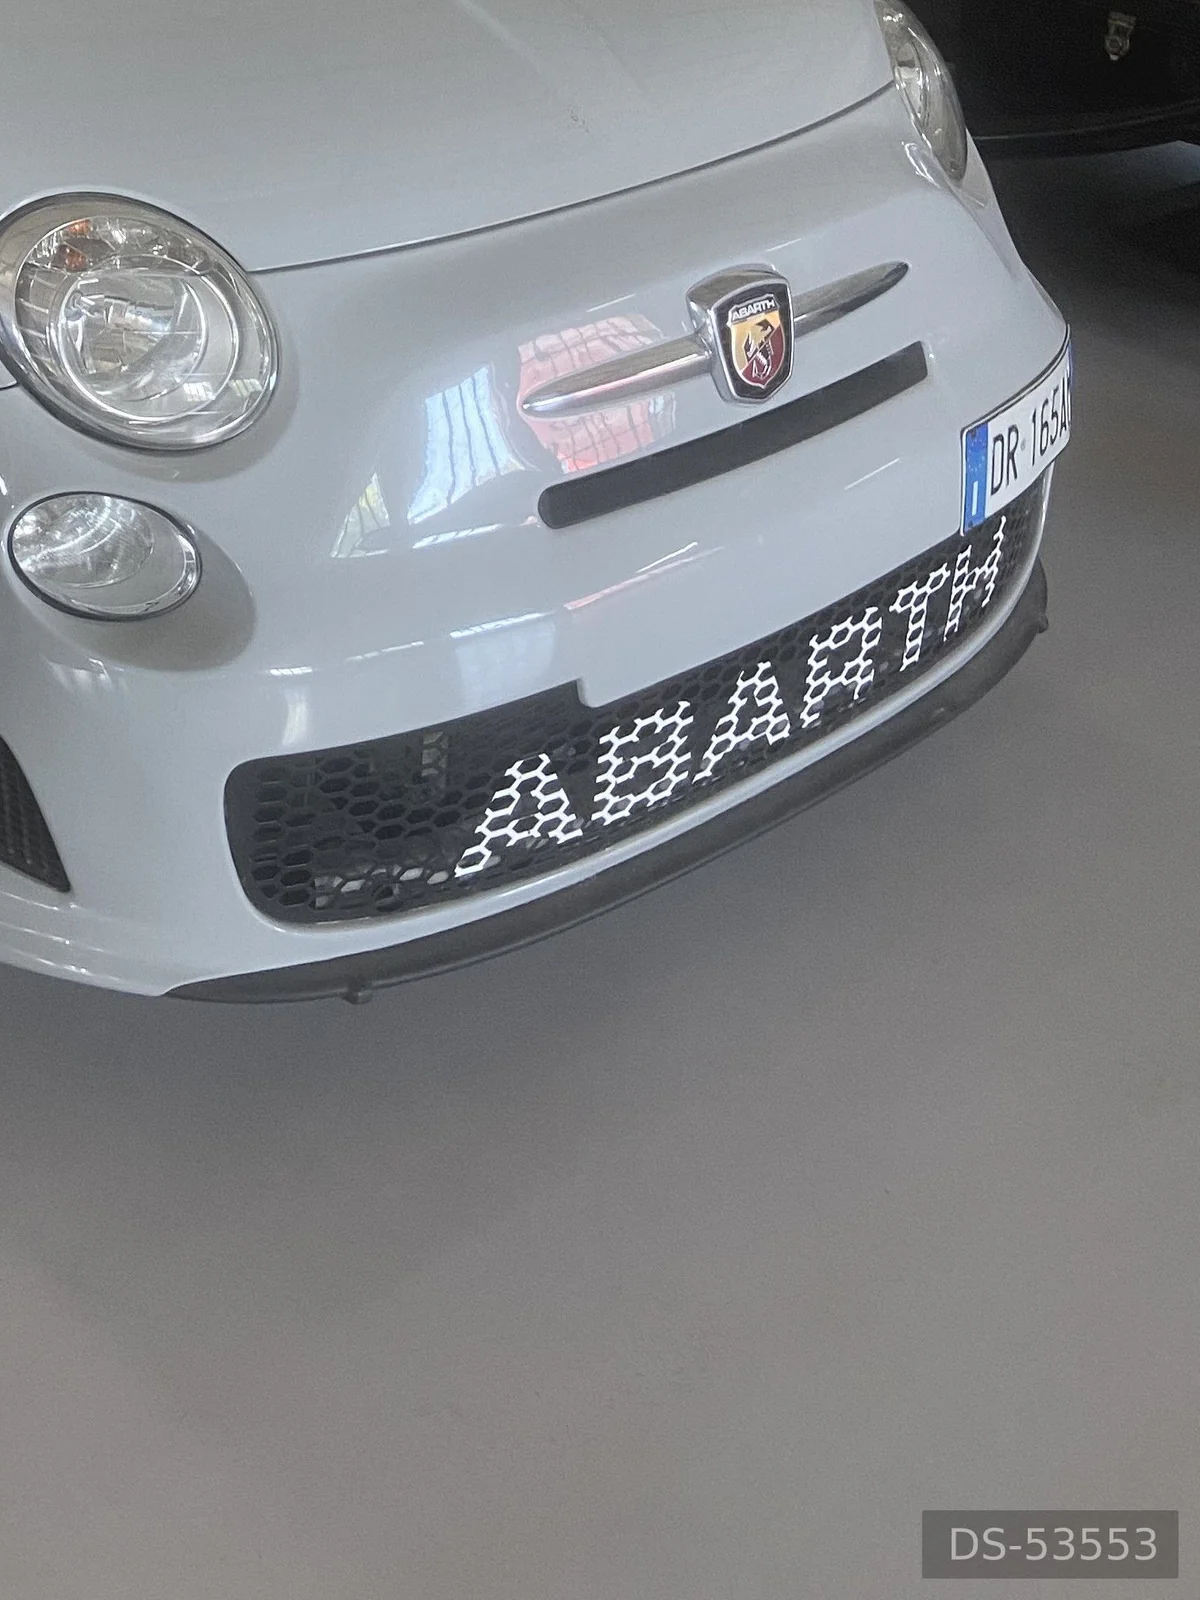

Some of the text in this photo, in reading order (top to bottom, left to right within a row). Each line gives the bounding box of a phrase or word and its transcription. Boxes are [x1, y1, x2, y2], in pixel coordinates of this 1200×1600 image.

[731, 298, 776, 322] ABARTH
[991, 424, 1019, 496] DR
[454, 515, 1006, 878] ABARTH
